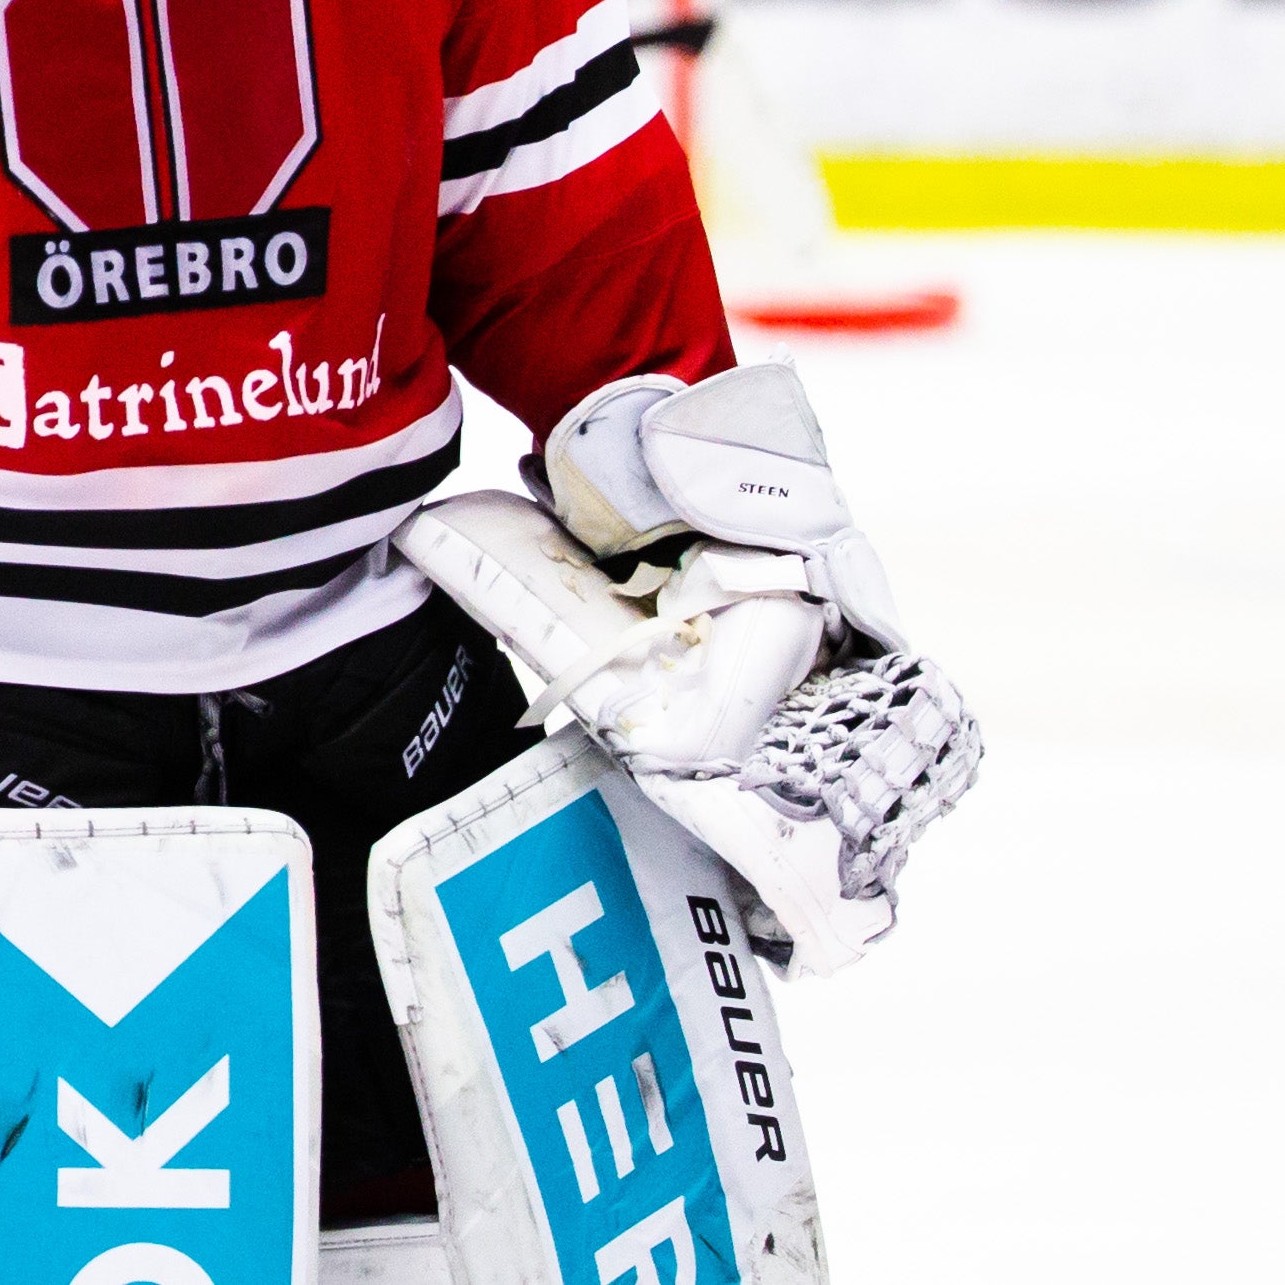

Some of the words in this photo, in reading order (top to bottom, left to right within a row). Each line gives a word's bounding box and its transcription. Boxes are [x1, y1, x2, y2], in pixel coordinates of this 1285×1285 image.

[36, 231, 308, 310] ÖREBRO
[738, 482, 789, 499] STEEN
[401, 644, 476, 780] BAUER
[685, 893, 787, 1164] BAUER
